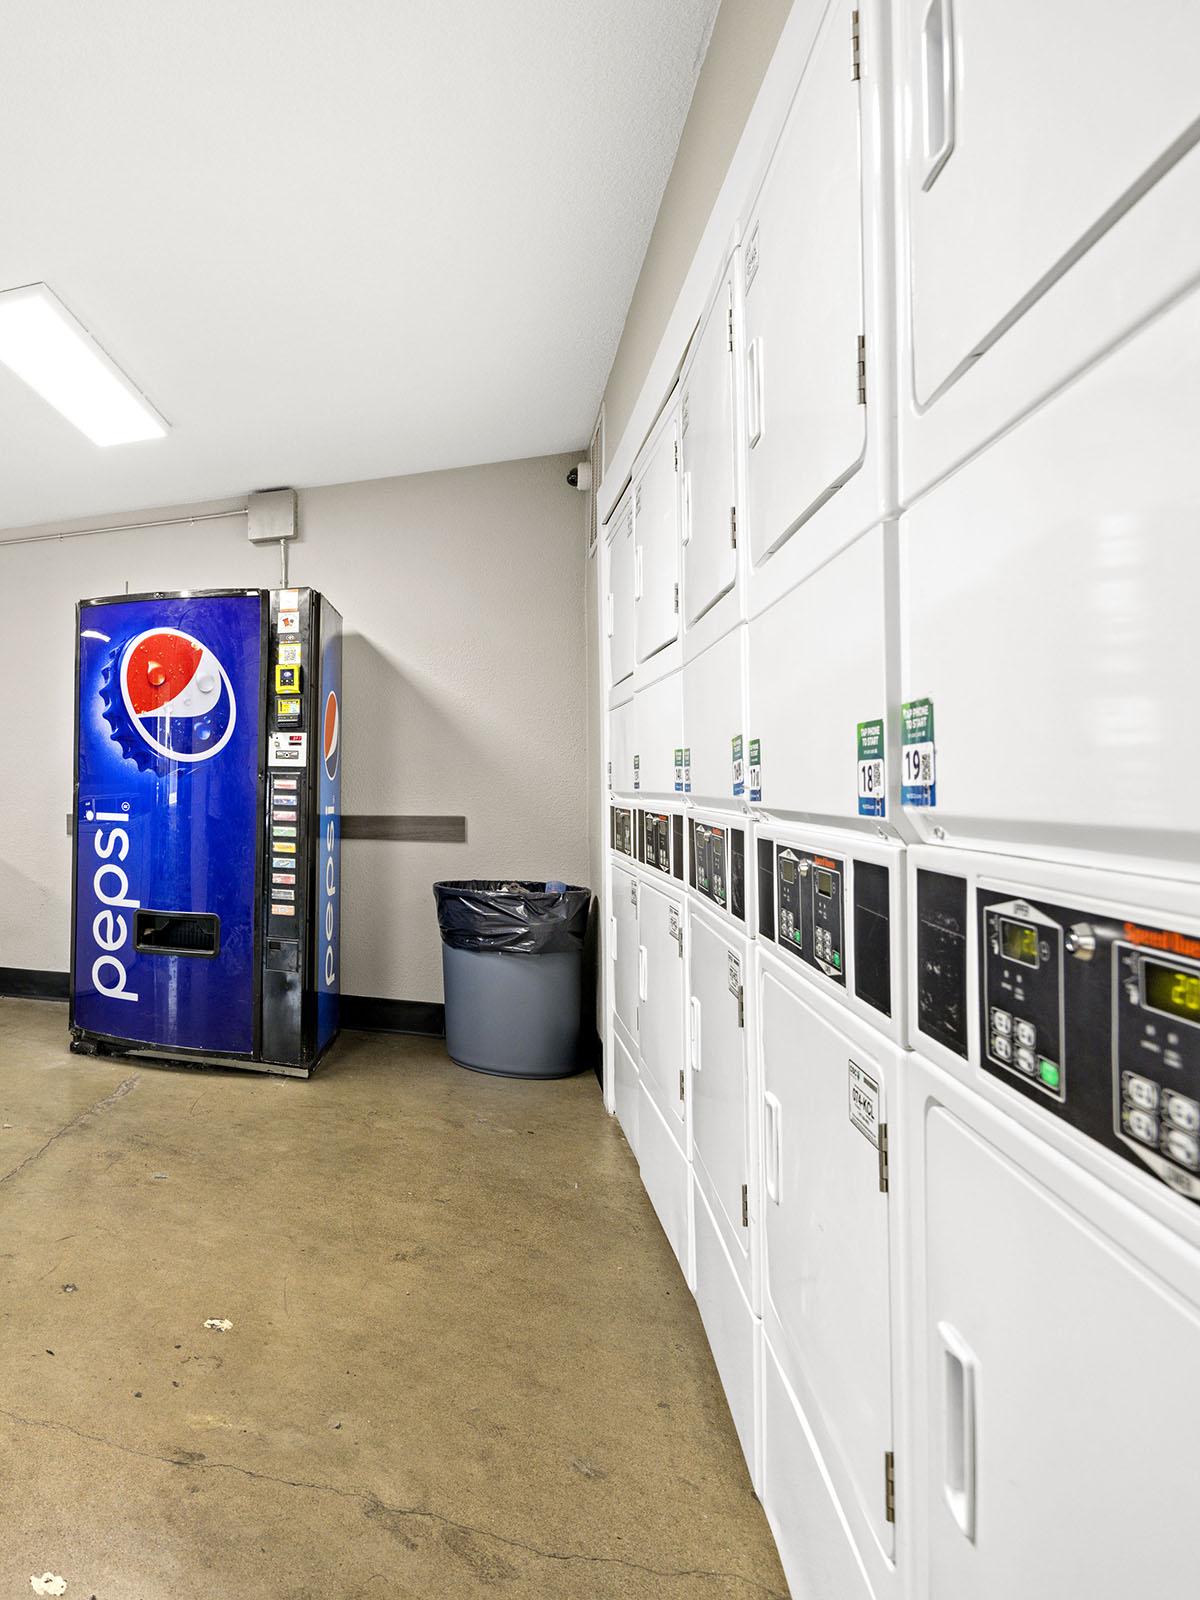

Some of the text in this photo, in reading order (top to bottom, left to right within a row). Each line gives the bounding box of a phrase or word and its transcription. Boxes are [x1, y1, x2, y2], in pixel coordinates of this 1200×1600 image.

[862, 765, 873, 792] 18
[906, 750, 920, 780] 19
[86, 811, 140, 1002] pepsi
[325, 804, 336, 986] pepsi
